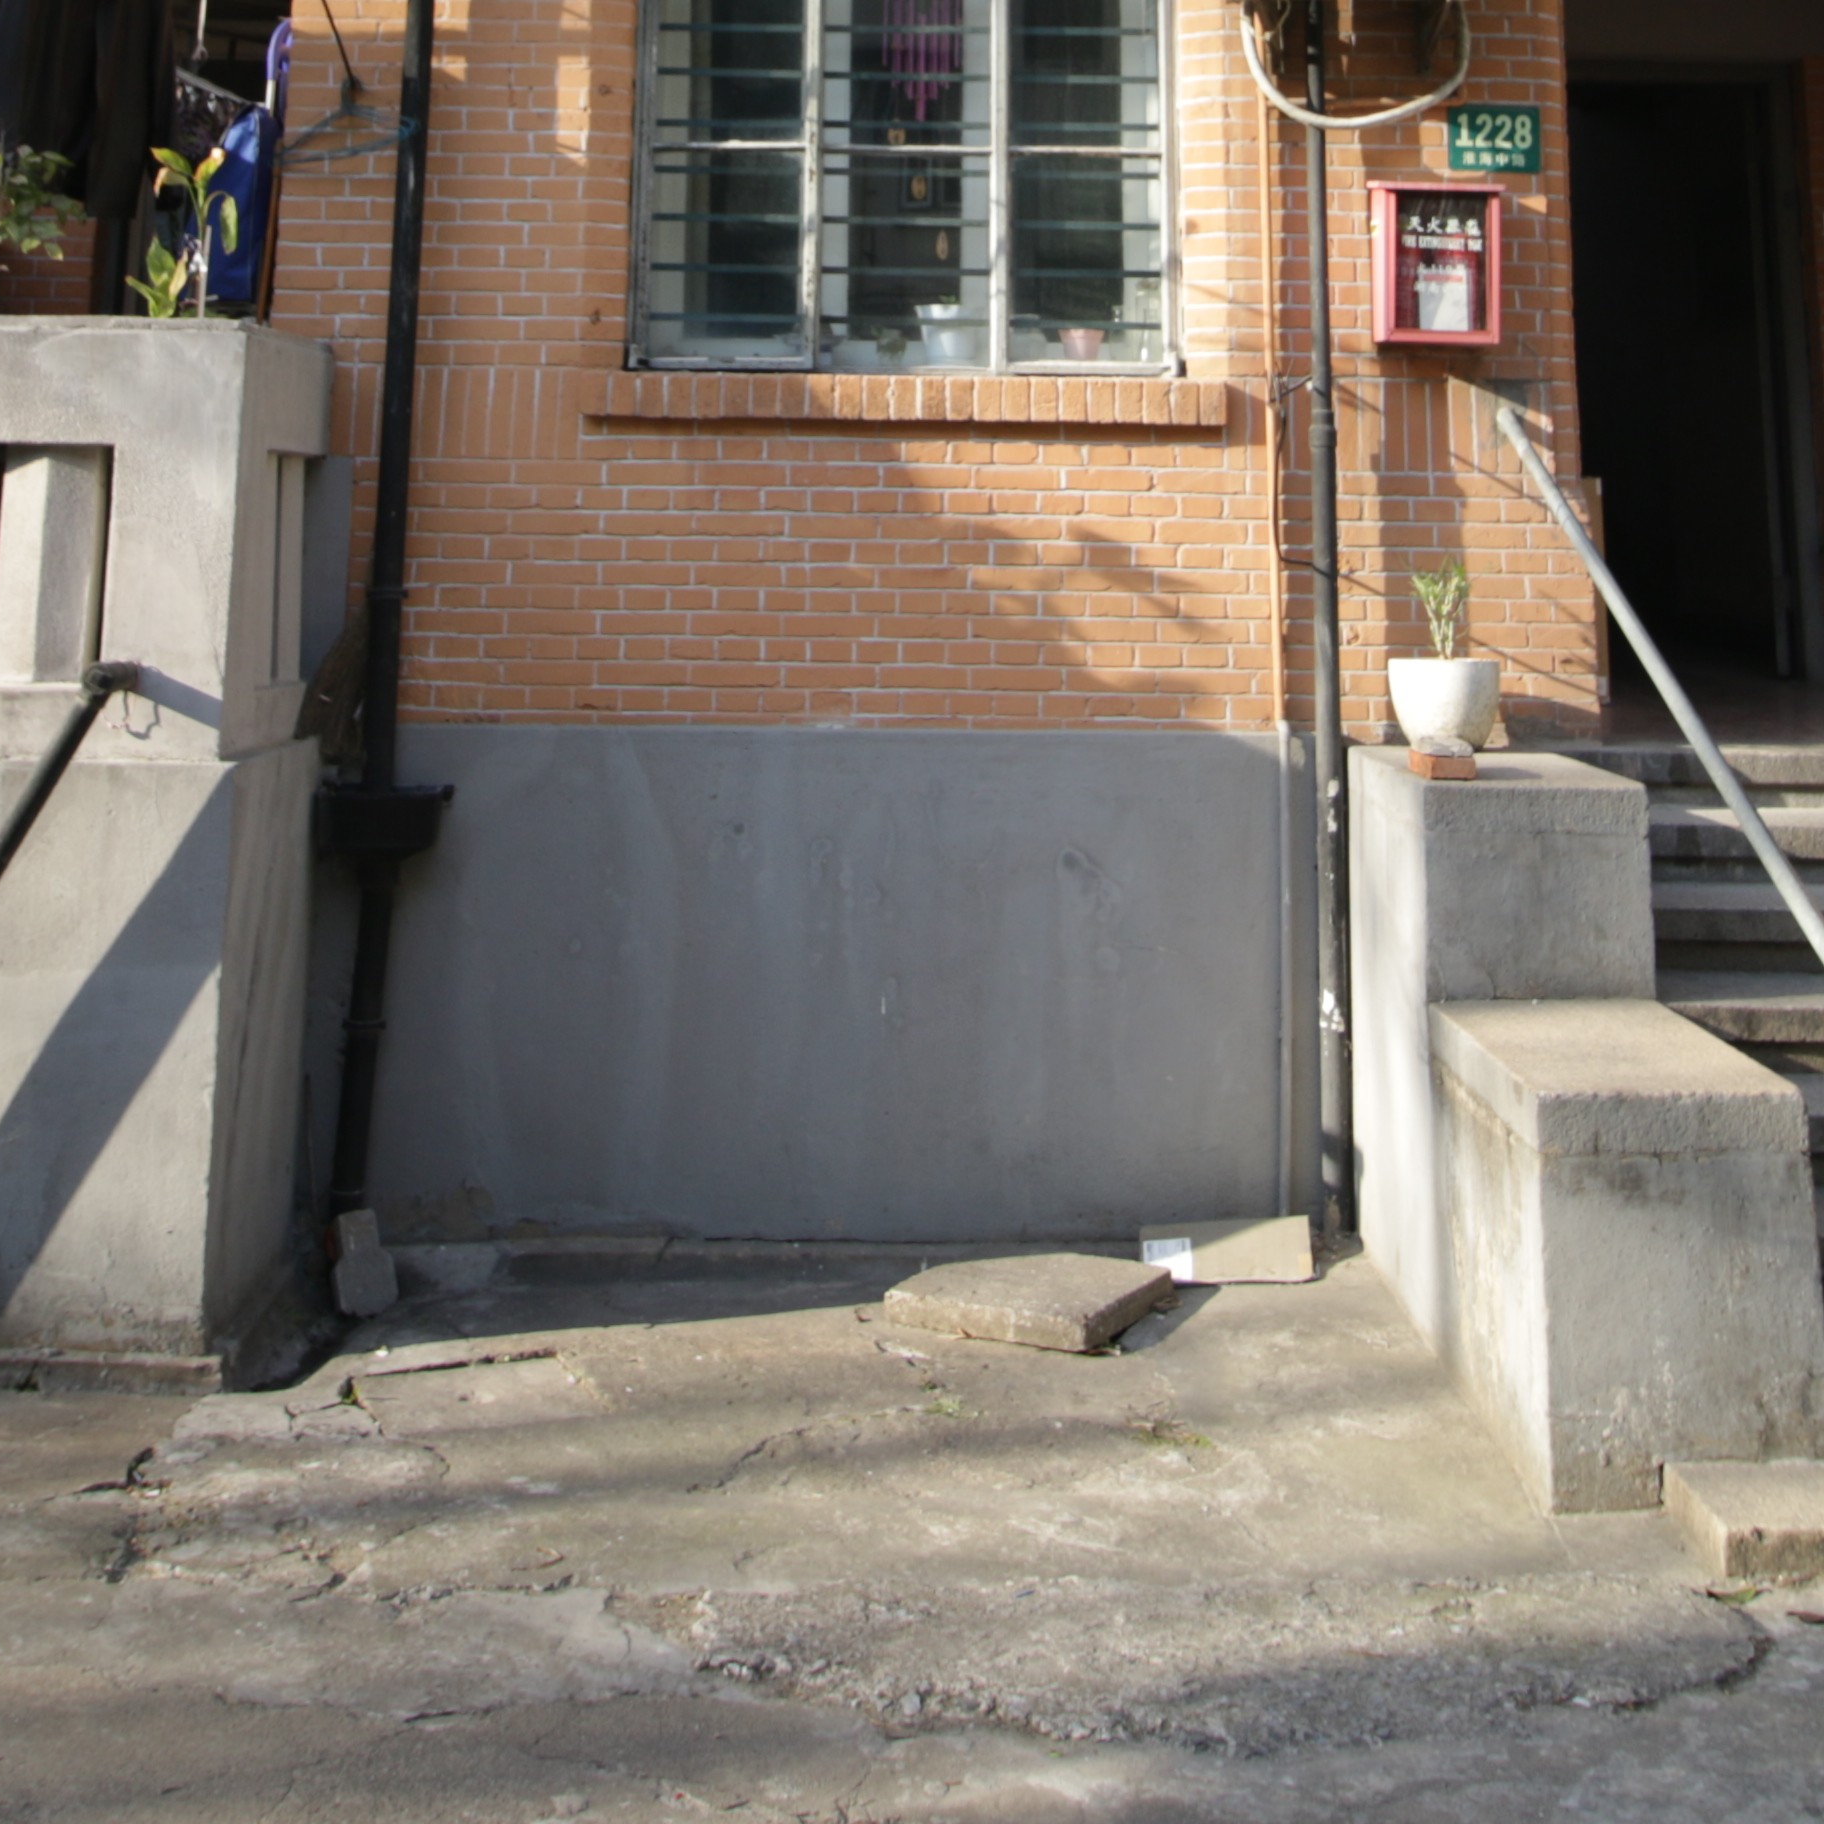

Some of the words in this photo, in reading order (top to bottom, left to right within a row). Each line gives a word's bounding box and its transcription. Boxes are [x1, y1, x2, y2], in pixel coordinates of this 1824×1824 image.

[1455, 114, 1533, 149] 1228
[1462, 151, 1526, 168] 淮海中路
